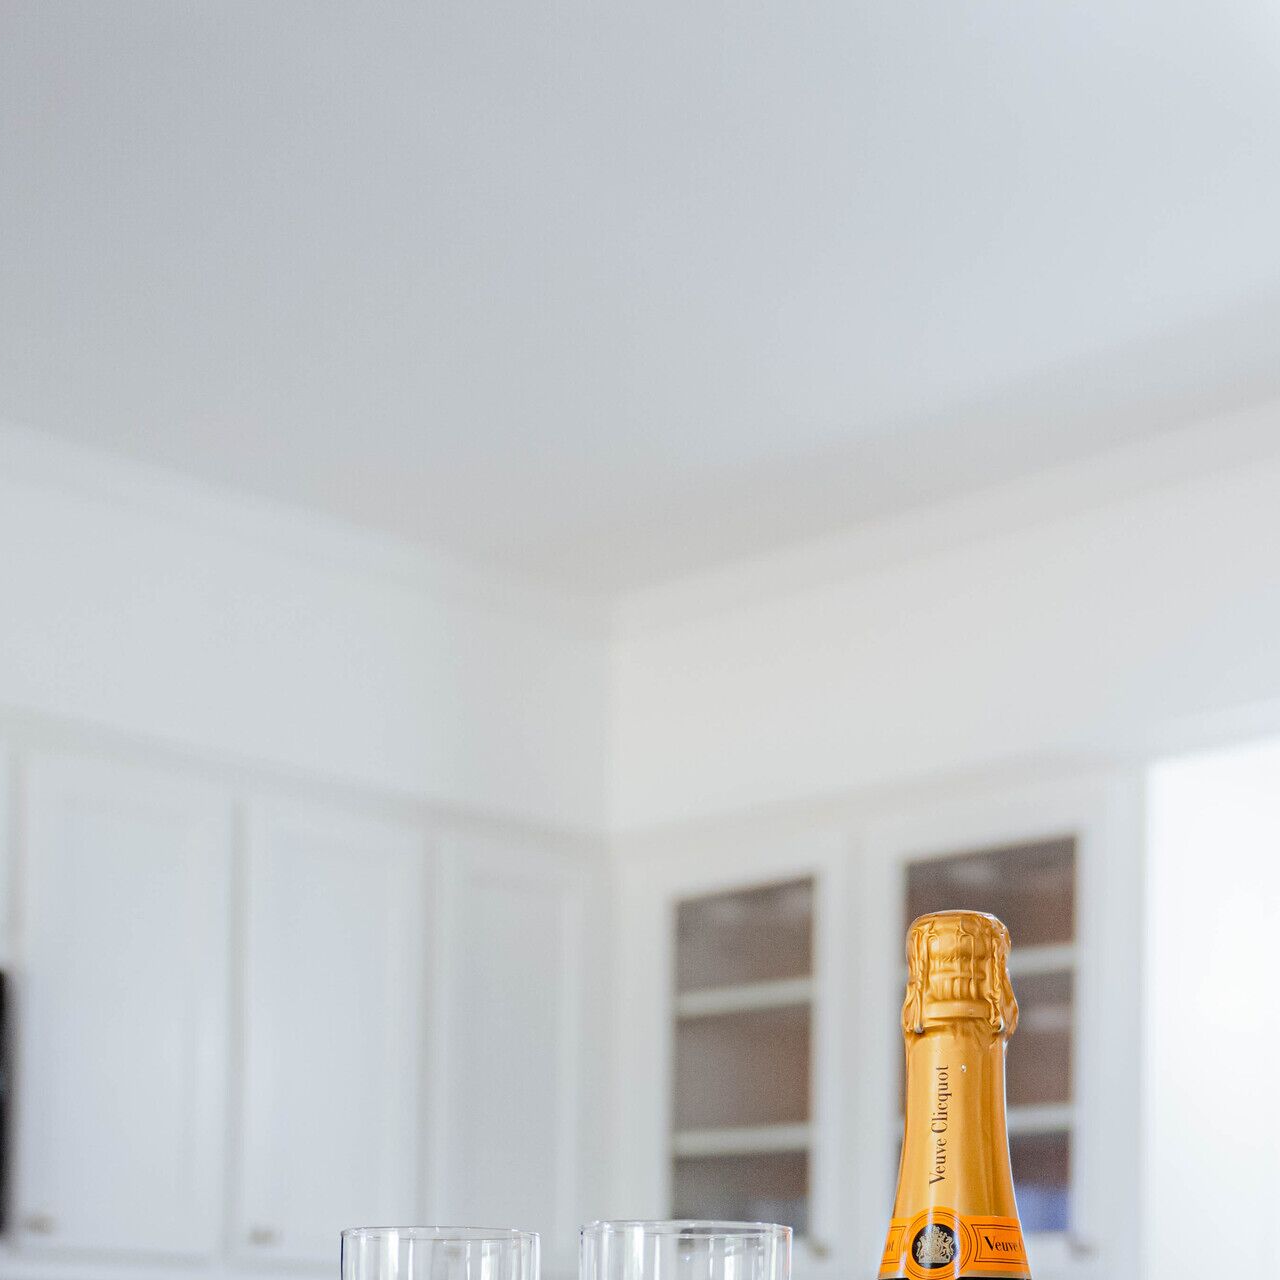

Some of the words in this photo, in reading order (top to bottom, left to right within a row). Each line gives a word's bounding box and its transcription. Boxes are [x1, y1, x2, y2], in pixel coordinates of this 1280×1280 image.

[930, 1064, 952, 1134] Clicquot
[929, 1138, 947, 1186] Veuve
[984, 1236, 1018, 1251] Veuve
